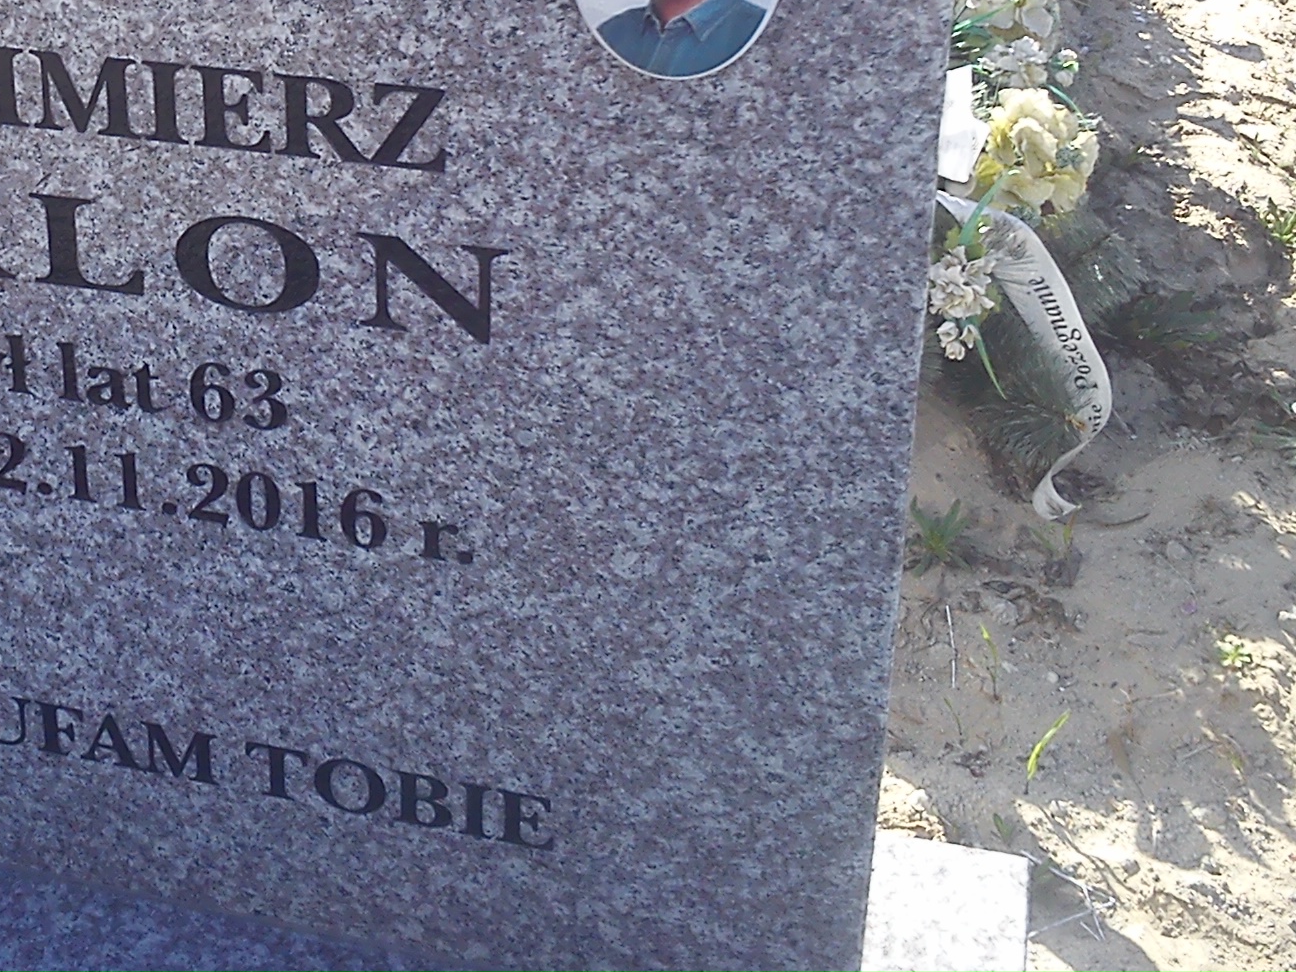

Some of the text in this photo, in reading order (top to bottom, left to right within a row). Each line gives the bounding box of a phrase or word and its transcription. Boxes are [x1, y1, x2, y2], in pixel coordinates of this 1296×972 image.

[1028, 276, 1098, 390] Pożegnanie
[57, 342, 170, 414] lat
[189, 362, 288, 429] 63
[420, 518, 475, 564] r.
[245, 741, 556, 850] TOBIE
